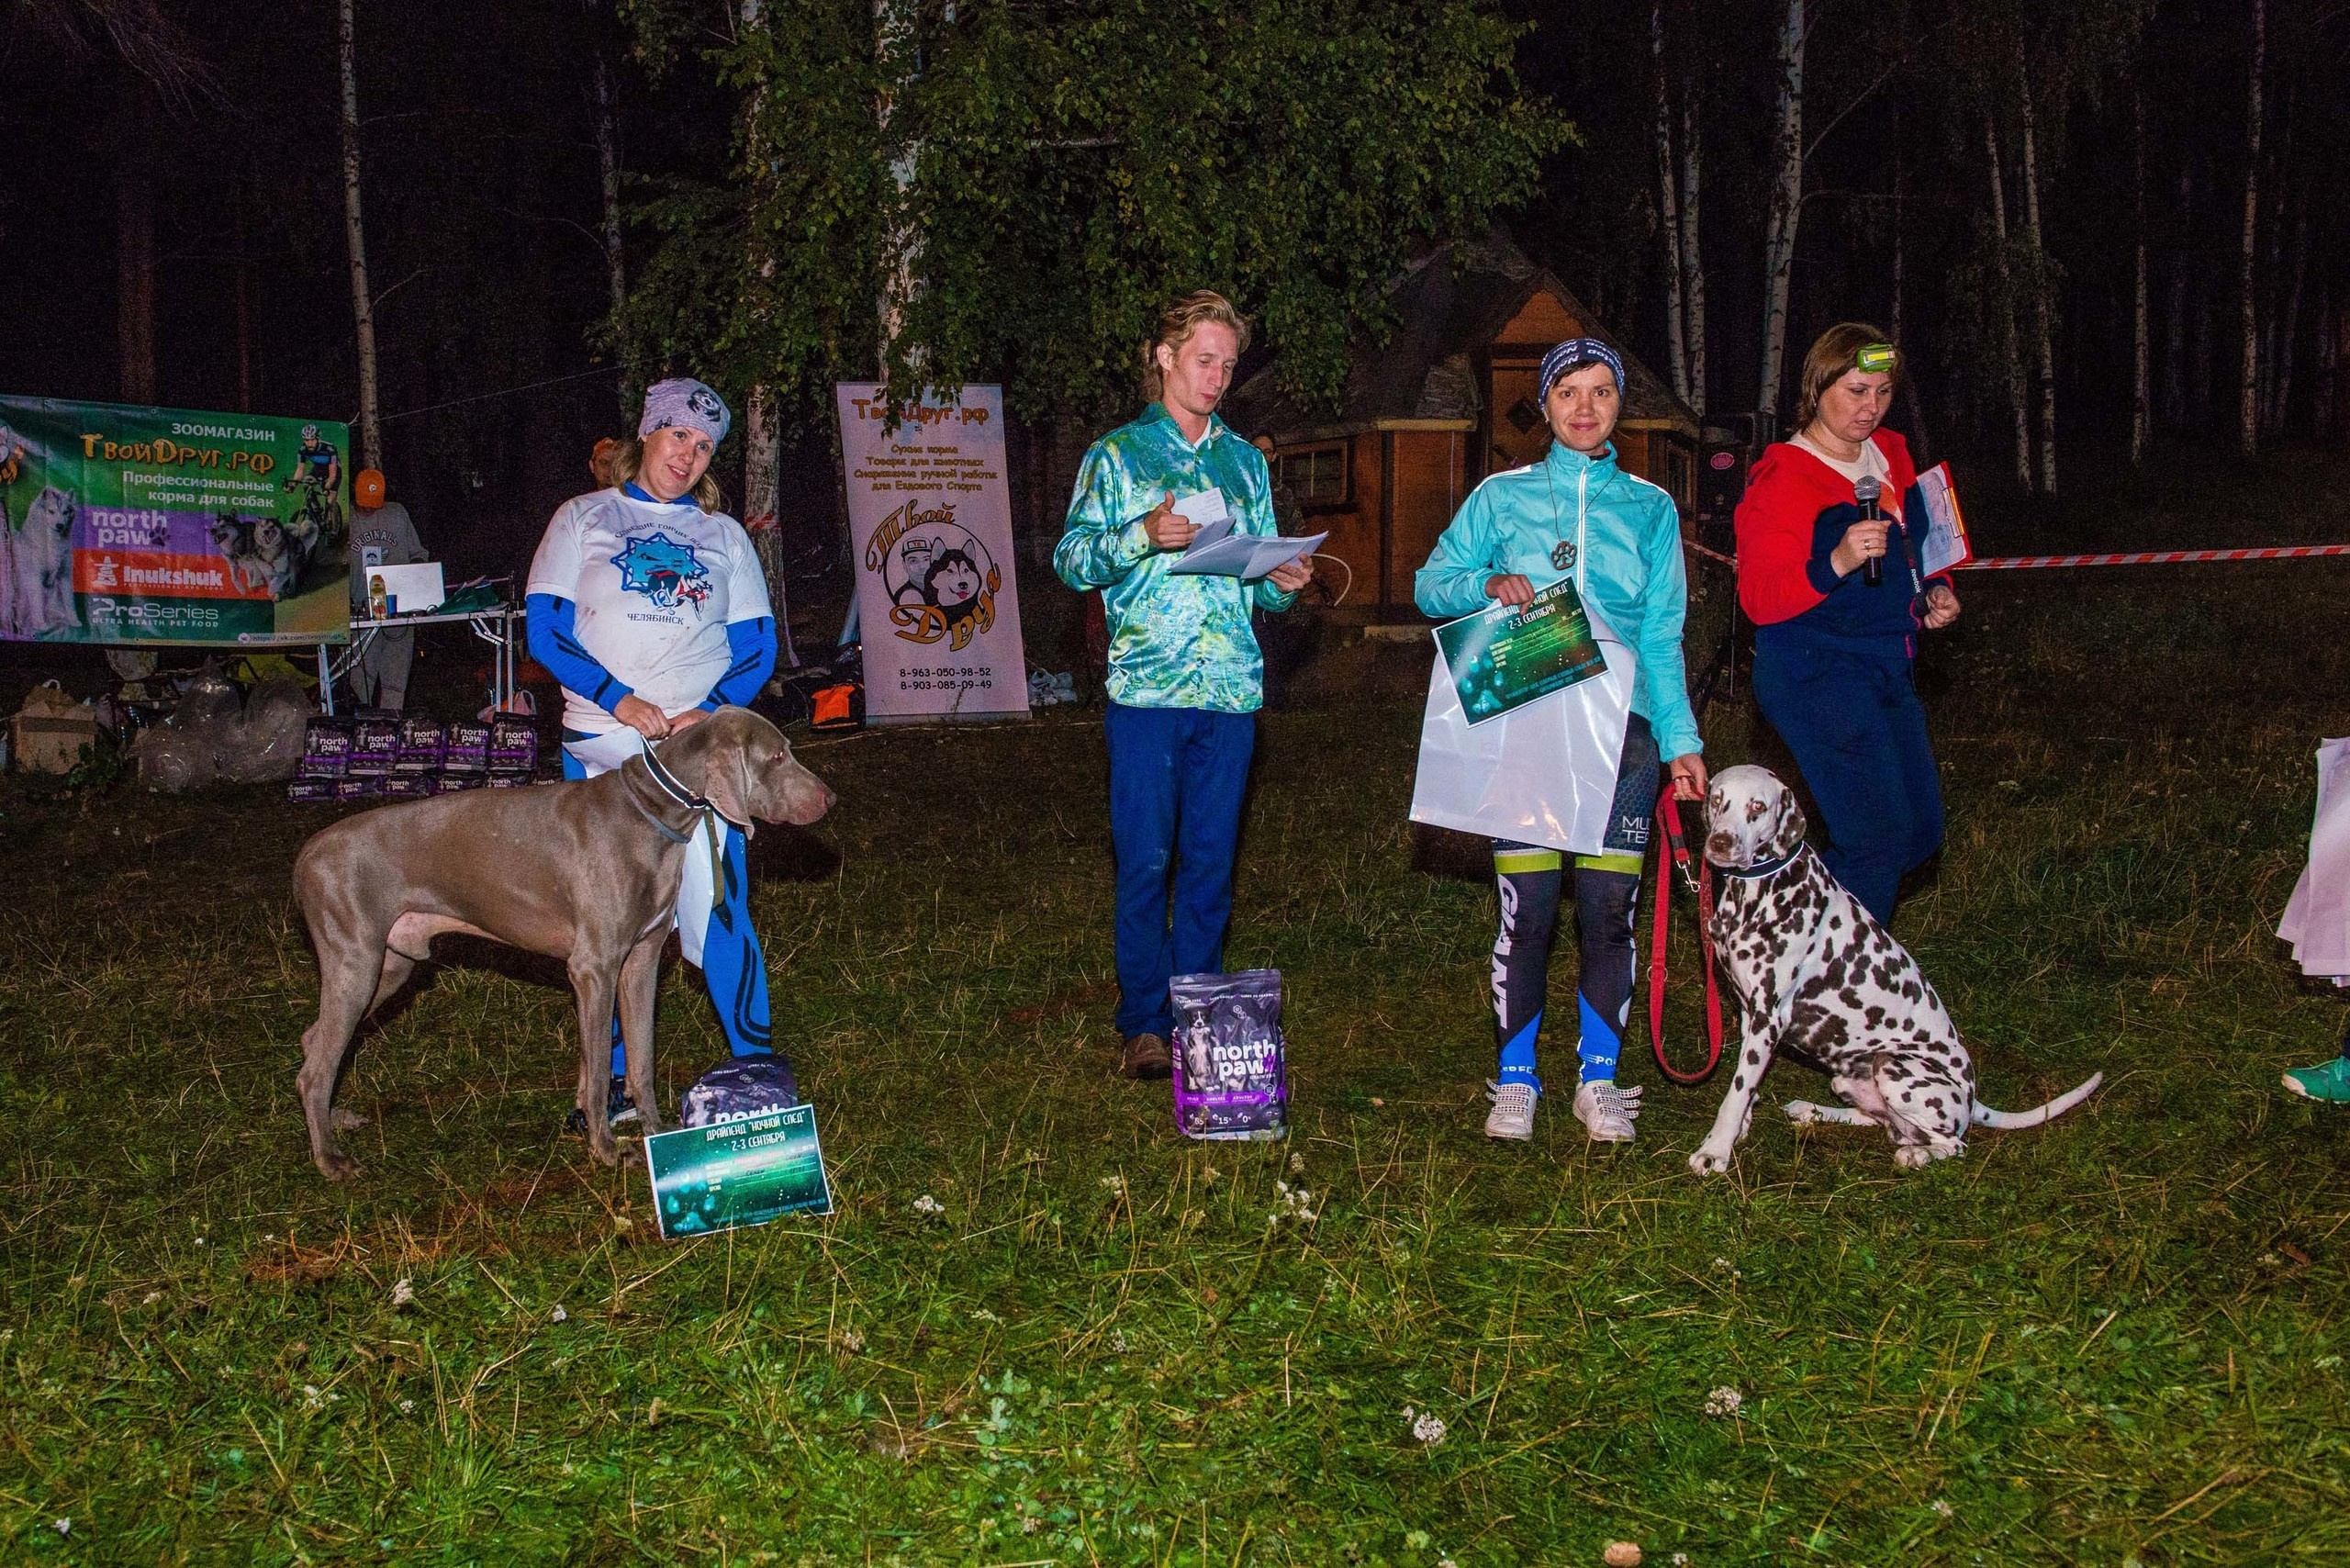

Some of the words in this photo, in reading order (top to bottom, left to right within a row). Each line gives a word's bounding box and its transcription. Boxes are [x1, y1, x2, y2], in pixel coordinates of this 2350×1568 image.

[172, 422, 275, 442] ЗООМАГАЗИН
[123, 470, 274, 492] Профессиональные
[149, 490, 195, 503] корма
[198, 494, 227, 506] для
[231, 494, 274, 508] собак
[93, 510, 167, 529] north
[98, 527, 151, 547] paw
[351, 530, 398, 553] ORIGINALS
[866, 498, 957, 574] Твой
[124, 566, 223, 587] Inukshuk
[1910, 568, 1921, 594] Reebok
[93, 597, 219, 621] ProSeries
[1508, 616, 1523, 631] 2-3
[1522, 602, 1557, 624] СЕНТЯБРЯ
[128, 619, 165, 627] HEALTH
[627, 613, 685, 625] ЧЕЛЯБИНСК
[900, 667, 991, 678] 8-963-050-98-52
[901, 680, 992, 690] 8-903-085-09-49
[319, 737, 348, 745] north
[368, 734, 395, 743] north
[414, 729, 440, 738] north
[415, 736, 434, 745] paw
[461, 728, 488, 737] north
[462, 735, 482, 744] paw
[506, 731, 533, 739] north
[1622, 815, 1652, 831] MU
[1491, 873, 1518, 1030] GIANT
[1214, 1039, 1276, 1061] north
[1219, 1060, 1264, 1081] paw
[706, 1123, 746, 1142] ДРАЙЛЕНД
[731, 1138, 746, 1151] 2-3
[748, 1131, 786, 1148] СЕНТЯБРЯ
